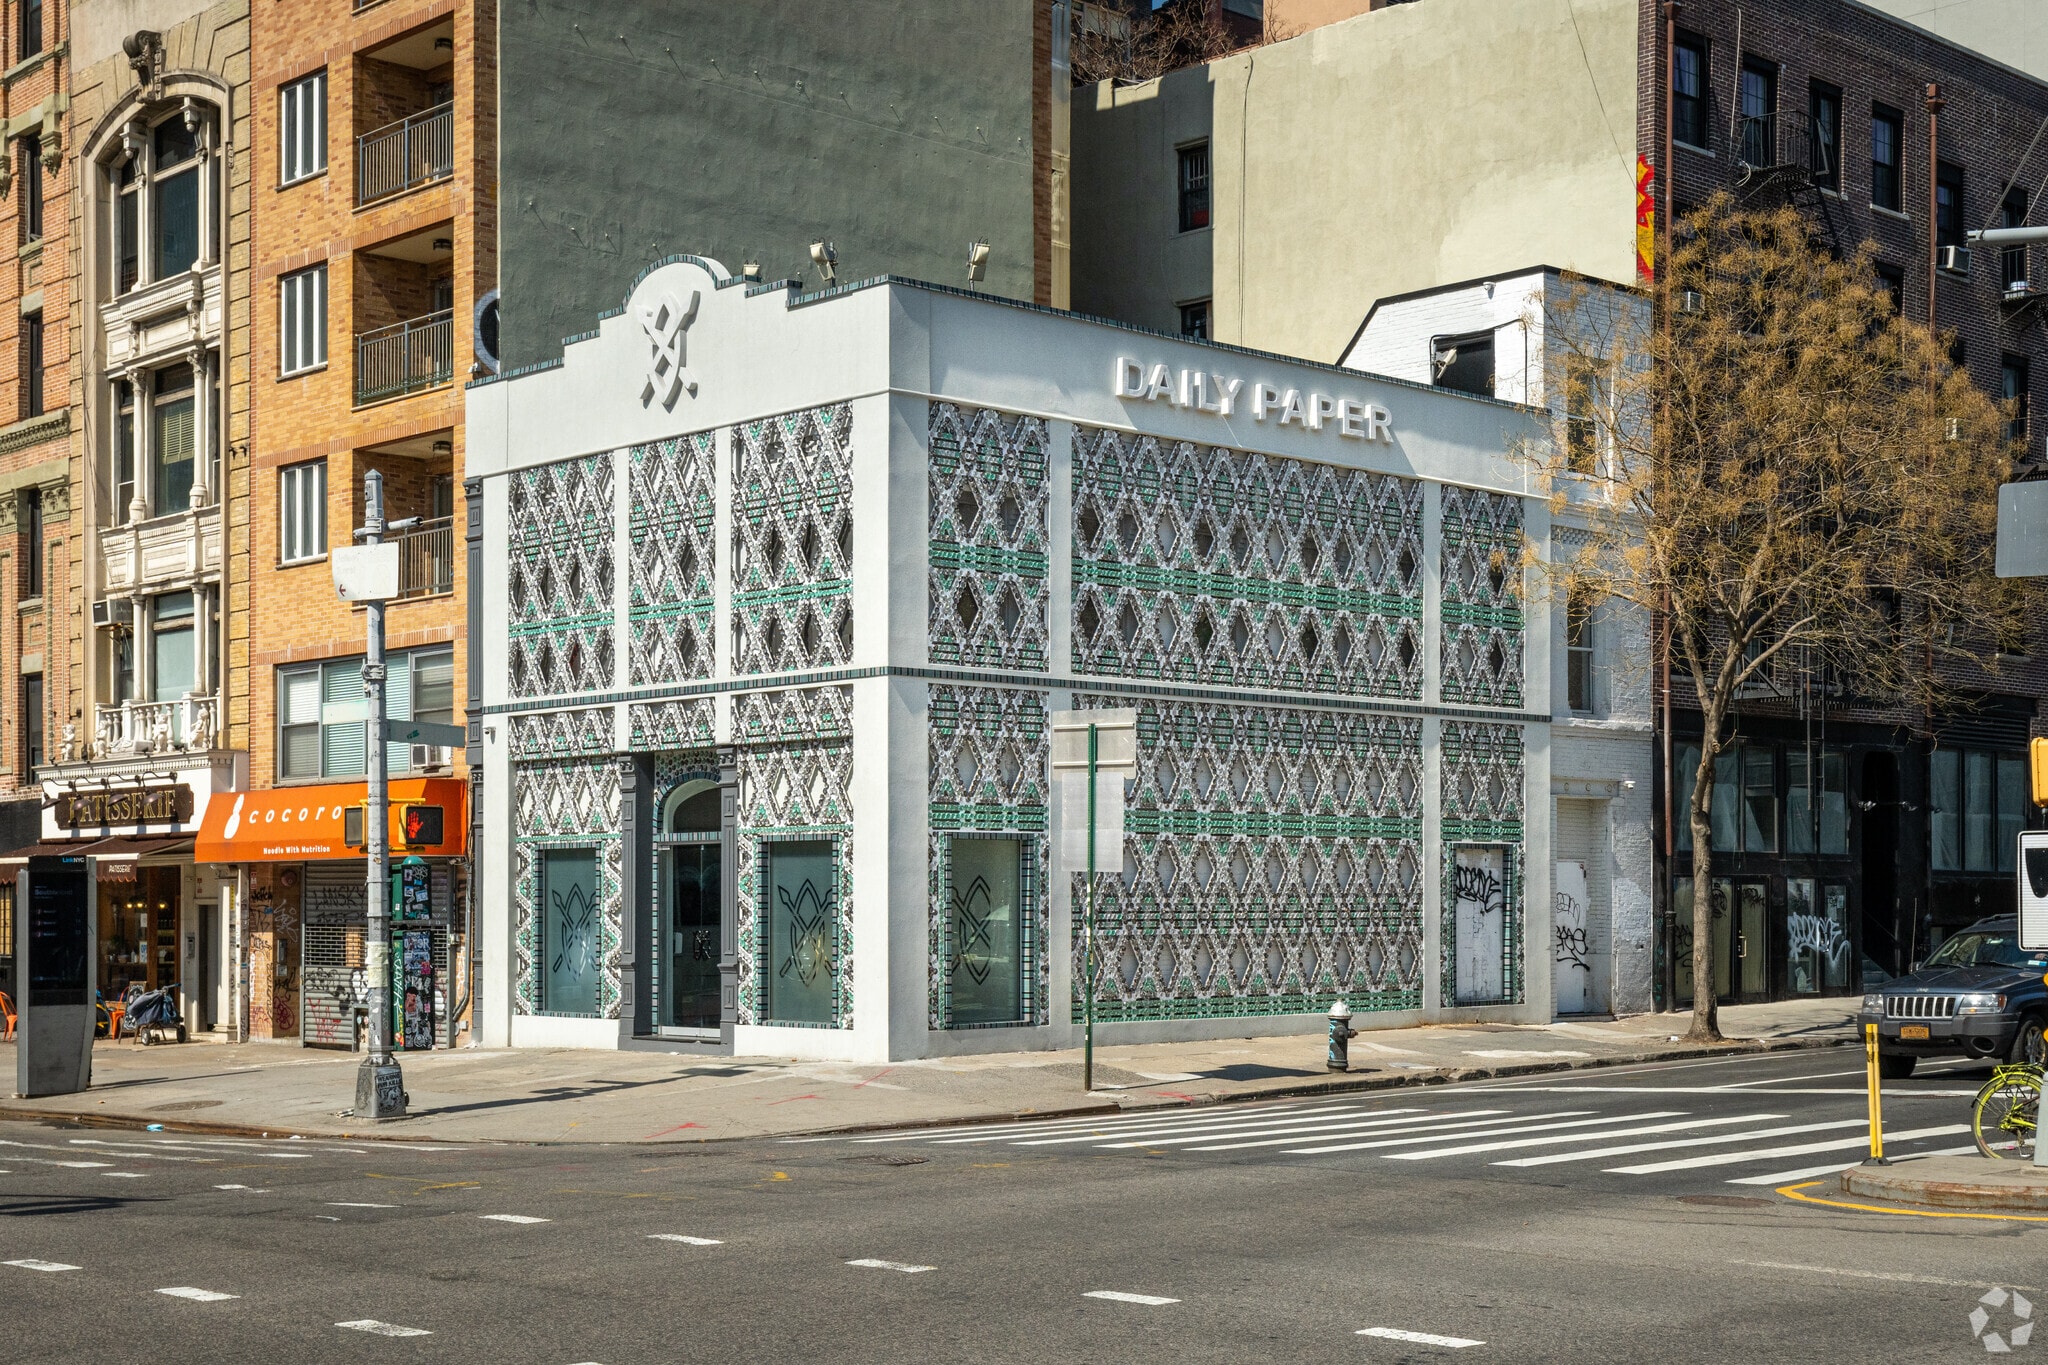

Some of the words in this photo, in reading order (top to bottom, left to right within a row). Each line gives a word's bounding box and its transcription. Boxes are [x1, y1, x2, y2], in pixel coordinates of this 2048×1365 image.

[1115, 356, 1245, 415] DAILY
[1254, 383, 1394, 443] PAPER
[249, 805, 342, 824] cocoro
[263, 847, 284, 855] Noodle
[286, 845, 300, 854] With
[301, 845, 331, 853] Nutrition
[109, 864, 132, 873] PATISSERIE
